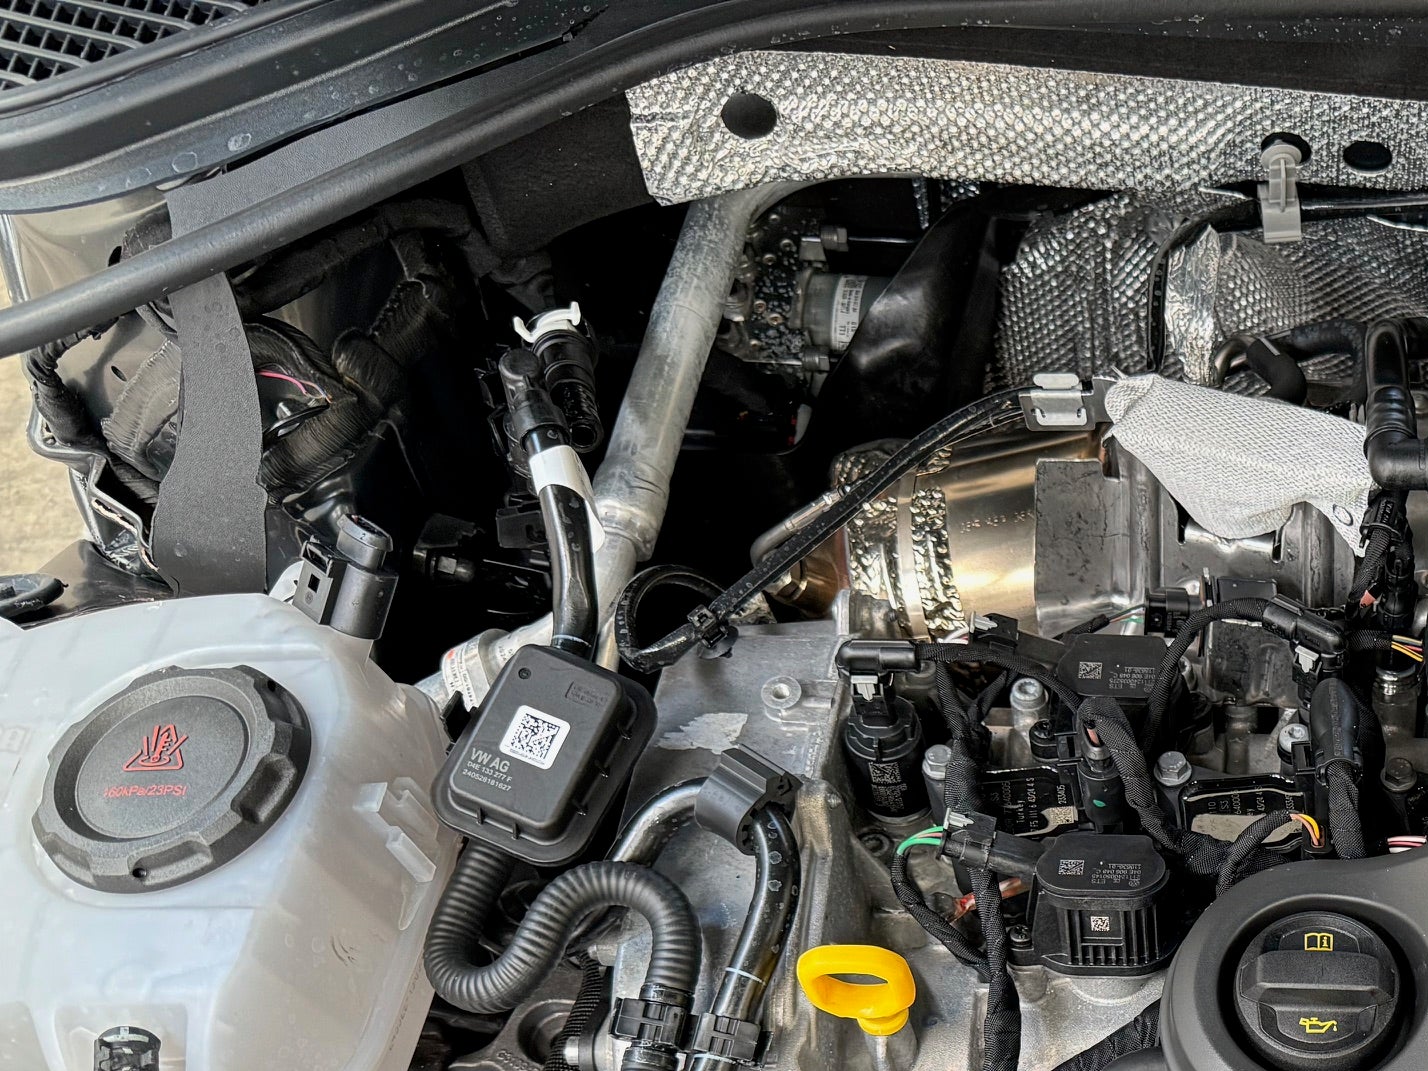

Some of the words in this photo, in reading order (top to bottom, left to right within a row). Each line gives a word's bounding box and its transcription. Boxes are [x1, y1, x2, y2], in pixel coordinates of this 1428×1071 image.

[471, 748, 492, 765] VW
[490, 757, 511, 773] AG
[482, 767, 494, 776] 133
[493, 771, 507, 781] 277
